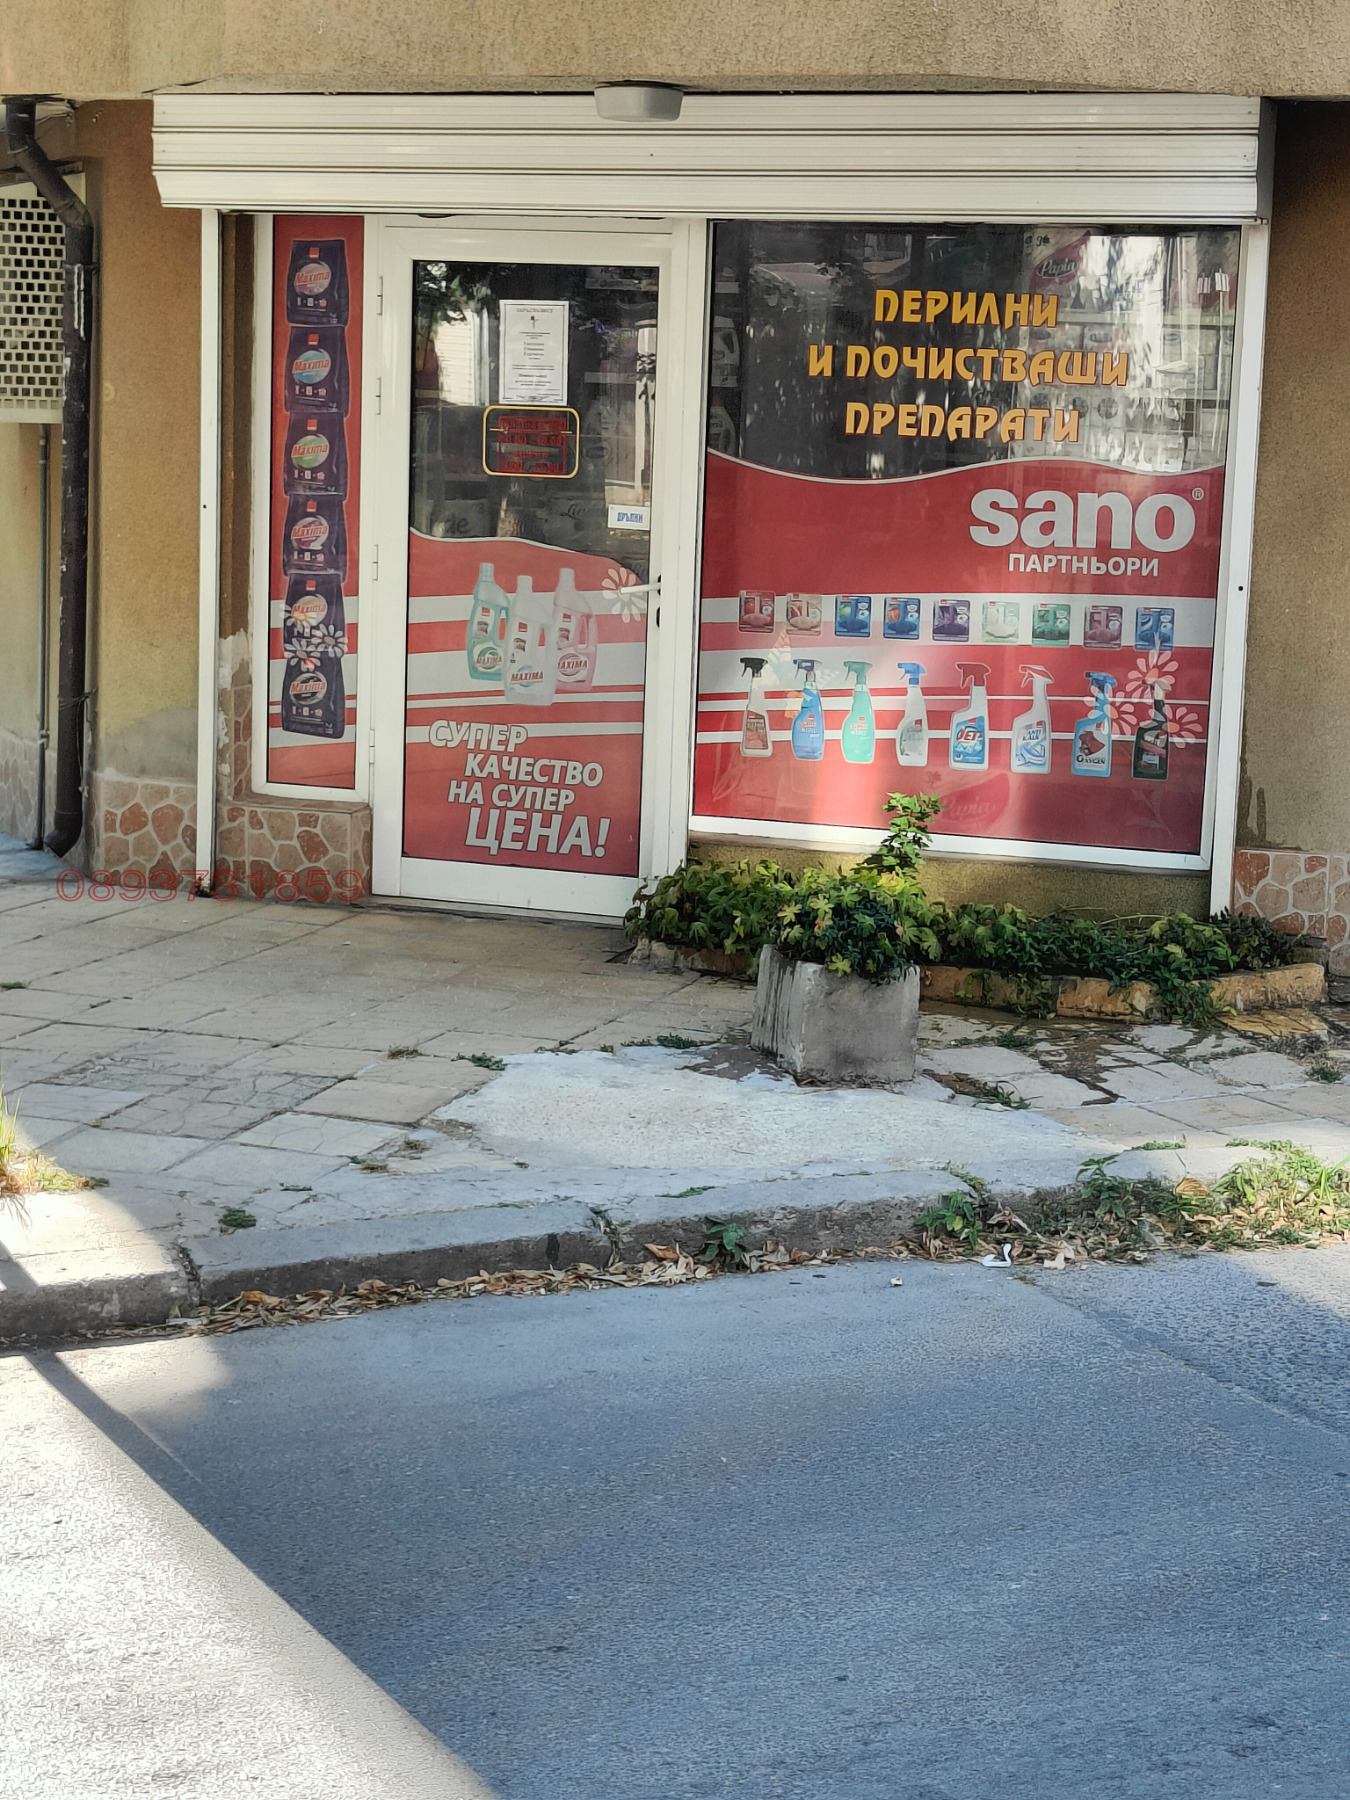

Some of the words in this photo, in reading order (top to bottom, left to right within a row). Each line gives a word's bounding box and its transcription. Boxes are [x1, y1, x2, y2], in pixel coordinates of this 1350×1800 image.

[874, 289, 1058, 329] ПЕРИЛНИ
[808, 344, 834, 377] И
[846, 345, 1129, 387] ПОЧИСТВАЩИ
[845, 402, 1081, 443] ПРЕПАРАТИ
[292, 444, 329, 457] Maxima
[969, 488, 1196, 553] sano
[1008, 553, 1159, 577] ПАРТНЬОРИ
[511, 672, 544, 681] MAXIMA
[429, 719, 528, 752] СУПЕР
[956, 730, 978, 741] JET
[464, 753, 604, 787] КАЧЕСТВО
[447, 780, 484, 805] НА
[491, 784, 575, 812] СУПЕР
[465, 807, 611, 858] ЦЕНА!
